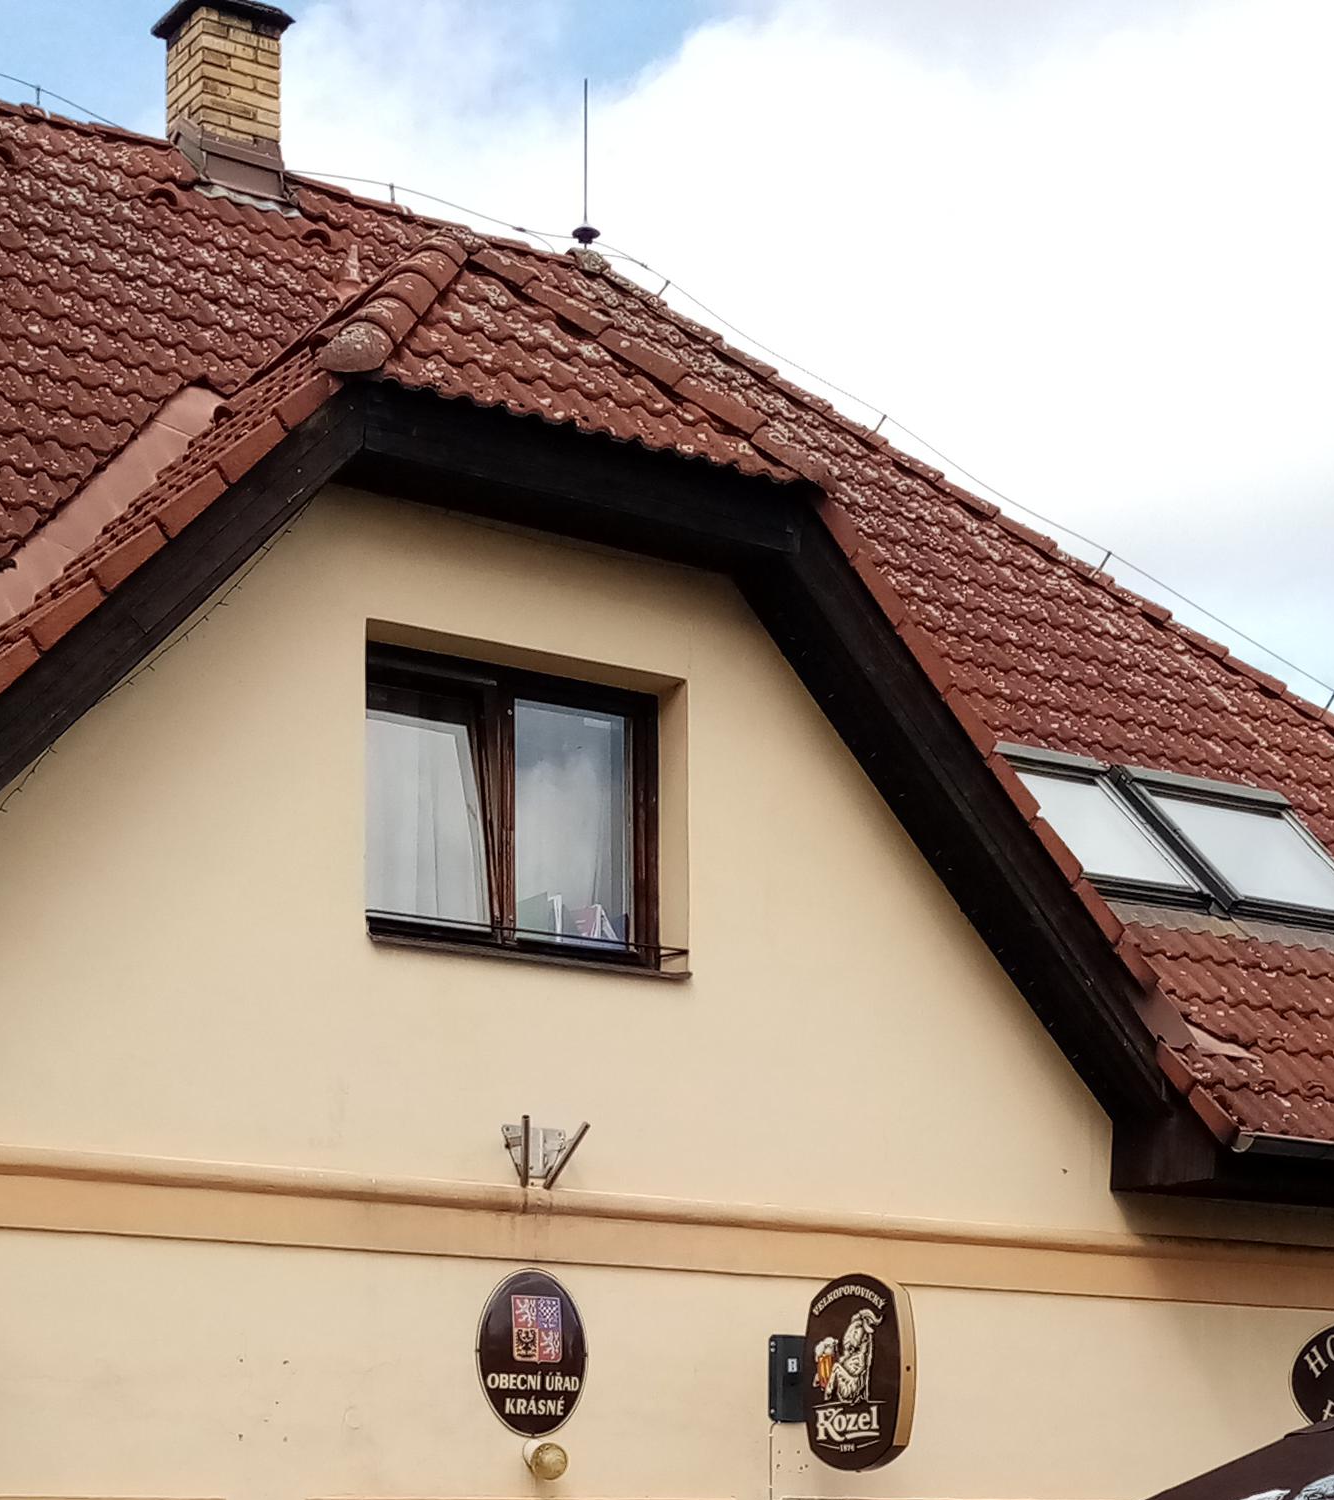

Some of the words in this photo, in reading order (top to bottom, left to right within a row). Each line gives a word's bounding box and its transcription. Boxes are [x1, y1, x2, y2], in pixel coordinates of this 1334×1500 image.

[487, 1371, 541, 1390] OBECNÍ
[545, 1371, 579, 1391] ÚŘAD
[505, 1395, 565, 1416] KRÁSNÉ
[816, 1406, 880, 1441] Kozel
